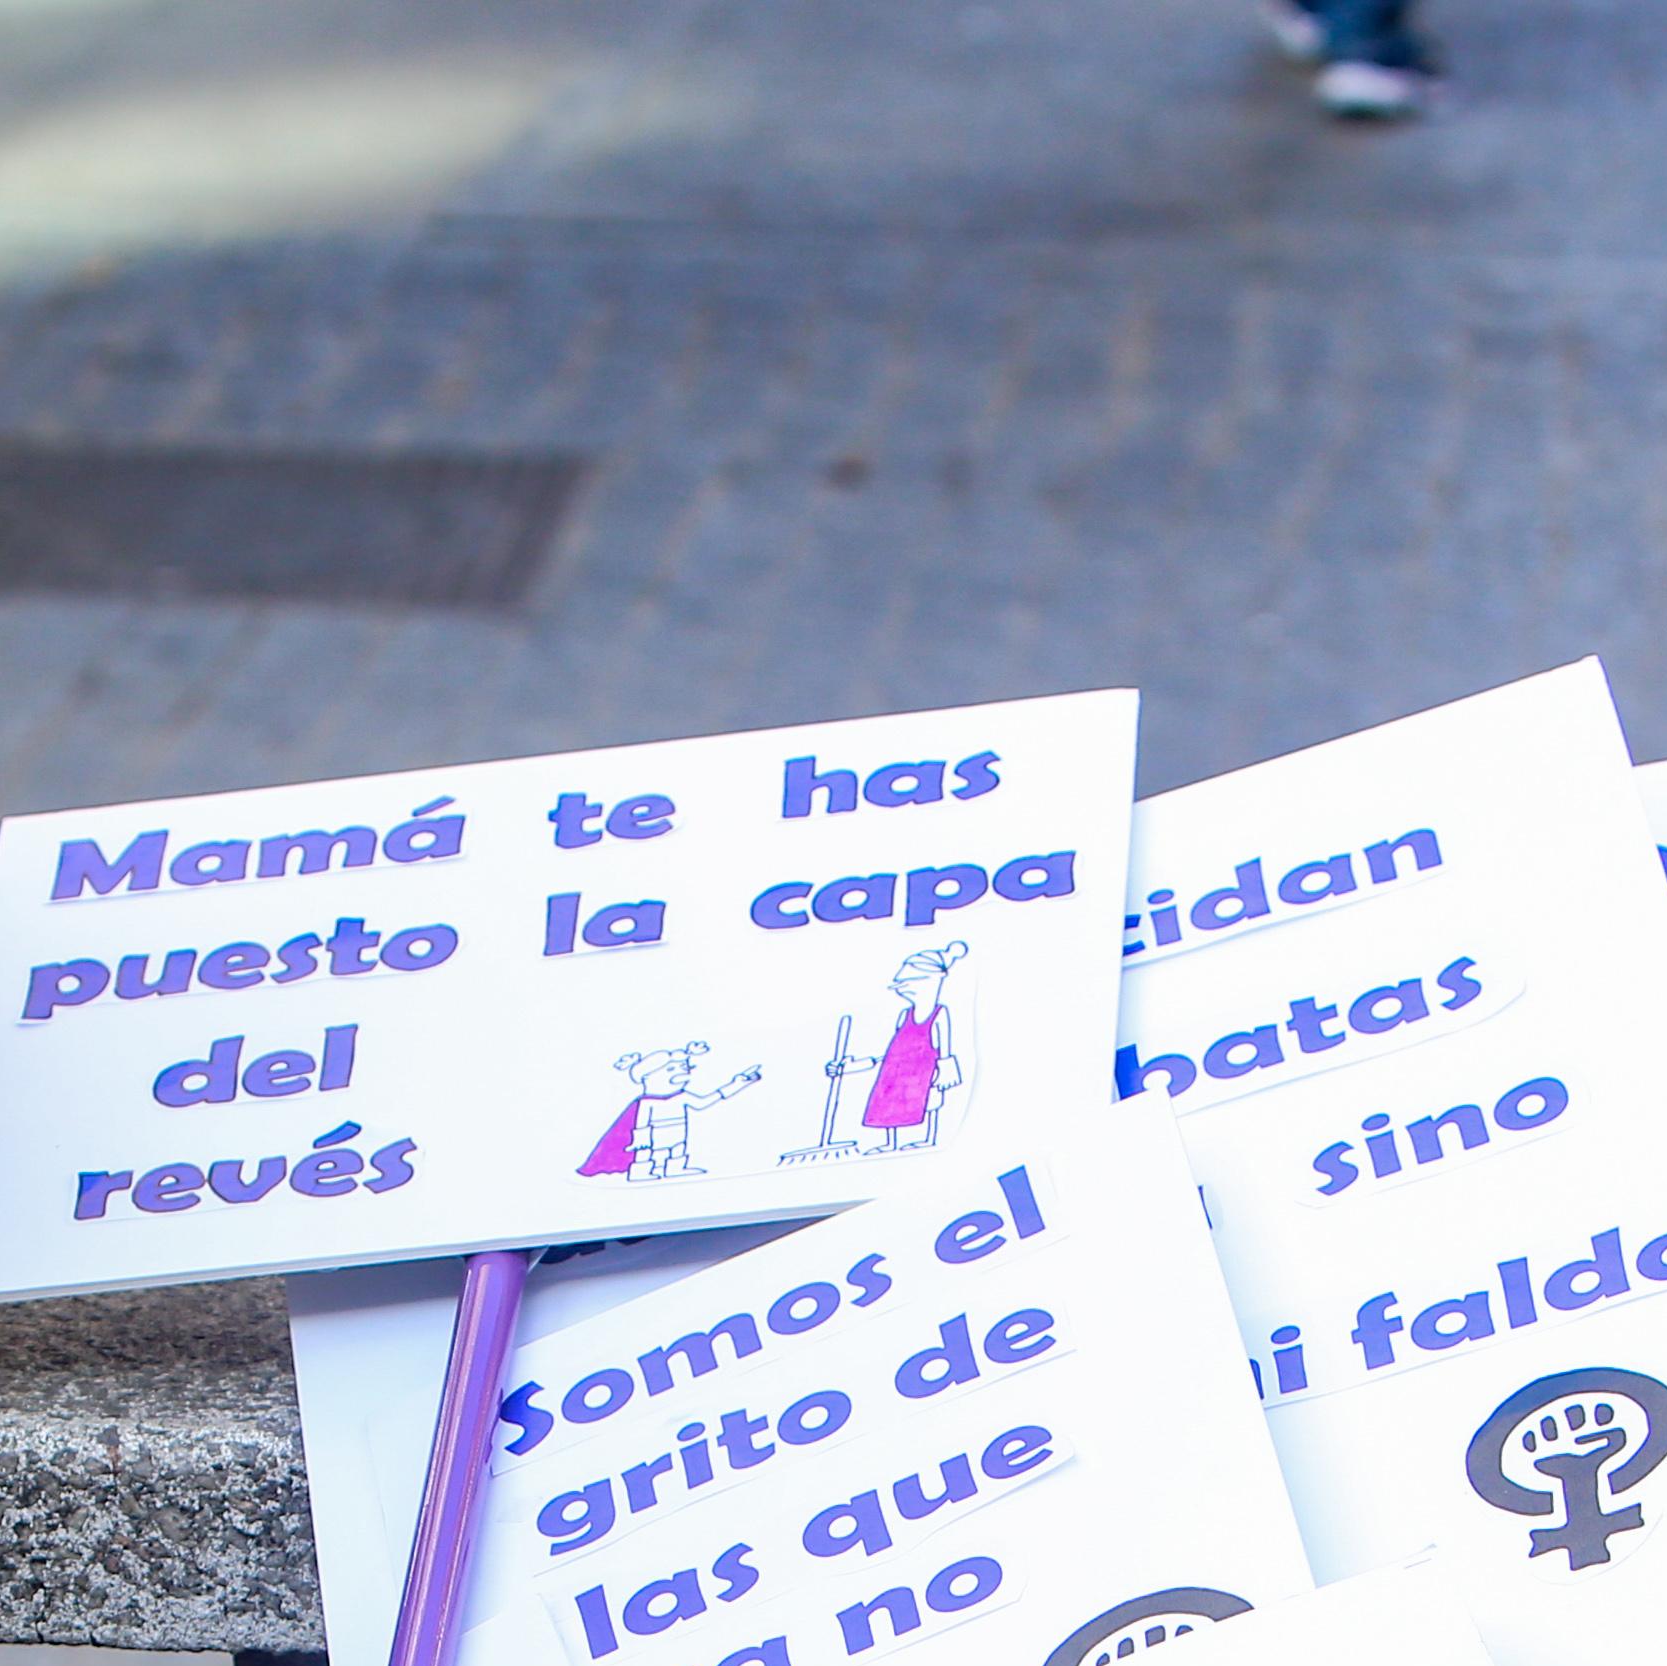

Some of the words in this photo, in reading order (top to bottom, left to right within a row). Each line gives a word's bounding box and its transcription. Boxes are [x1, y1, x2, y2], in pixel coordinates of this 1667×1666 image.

[51, 796, 466, 901] Mamá
[548, 792, 676, 850] te
[781, 750, 1002, 820] has
[20, 916, 459, 1021] puesto
[542, 892, 667, 957] la
[750, 850, 1077, 930] capa
[152, 1023, 359, 1108] del
[1312, 1076, 1570, 1196] sino
[73, 1120, 418, 1221] revés
[497, 1252, 893, 1457] Somos
[934, 1164, 1047, 1266] el
[536, 1389, 853, 1557] grito
[894, 1306, 1057, 1400] de
[574, 1542, 760, 1660] las
[802, 1424, 1054, 1558] que
[835, 1556, 1004, 1657] no
